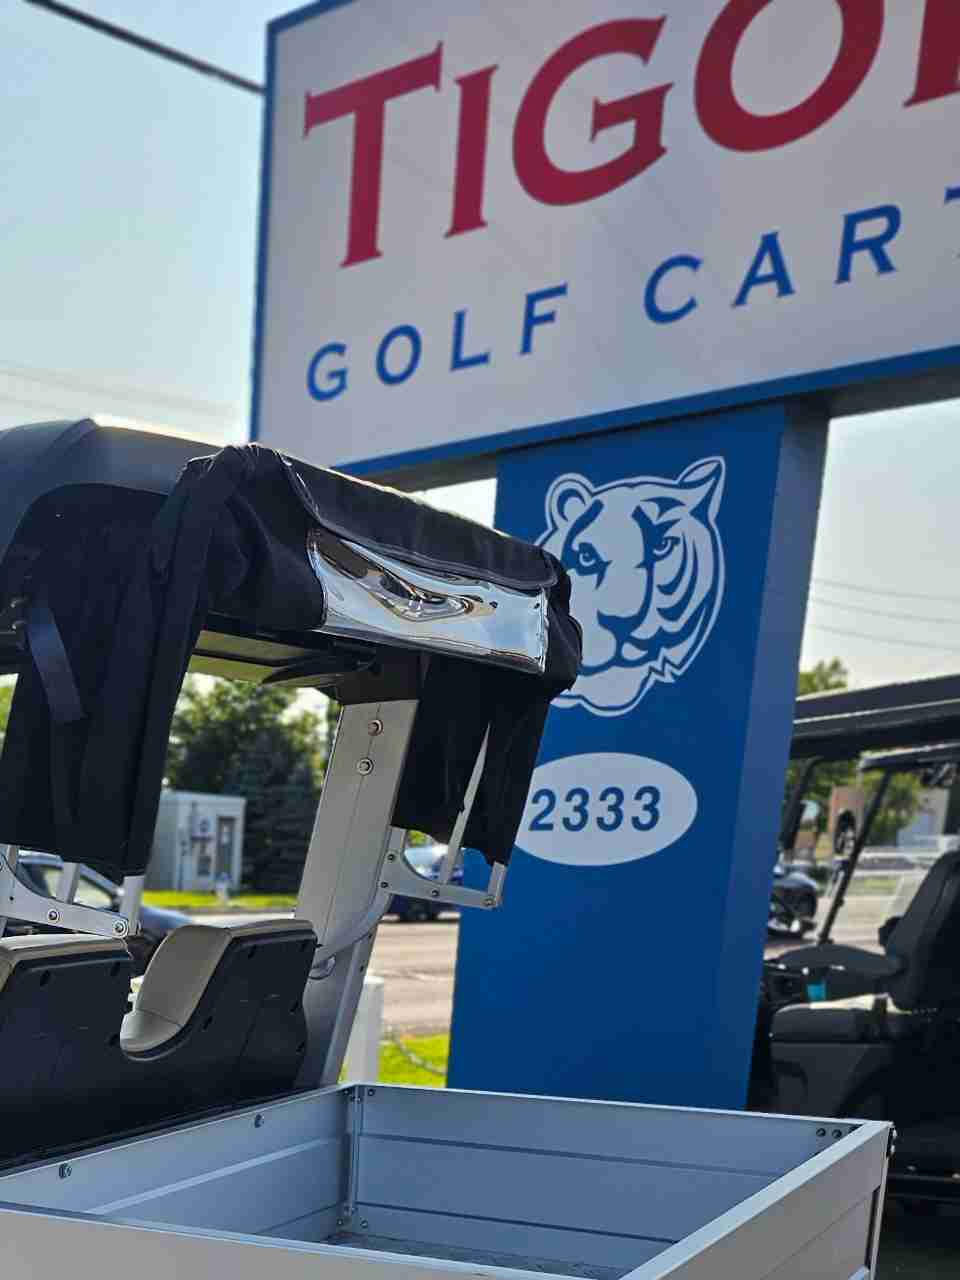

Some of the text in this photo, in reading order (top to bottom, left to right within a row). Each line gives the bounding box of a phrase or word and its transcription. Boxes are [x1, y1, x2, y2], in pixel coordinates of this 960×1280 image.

[306, 185, 960, 402] GOLF CAR
[528, 785, 661, 832] 2333
